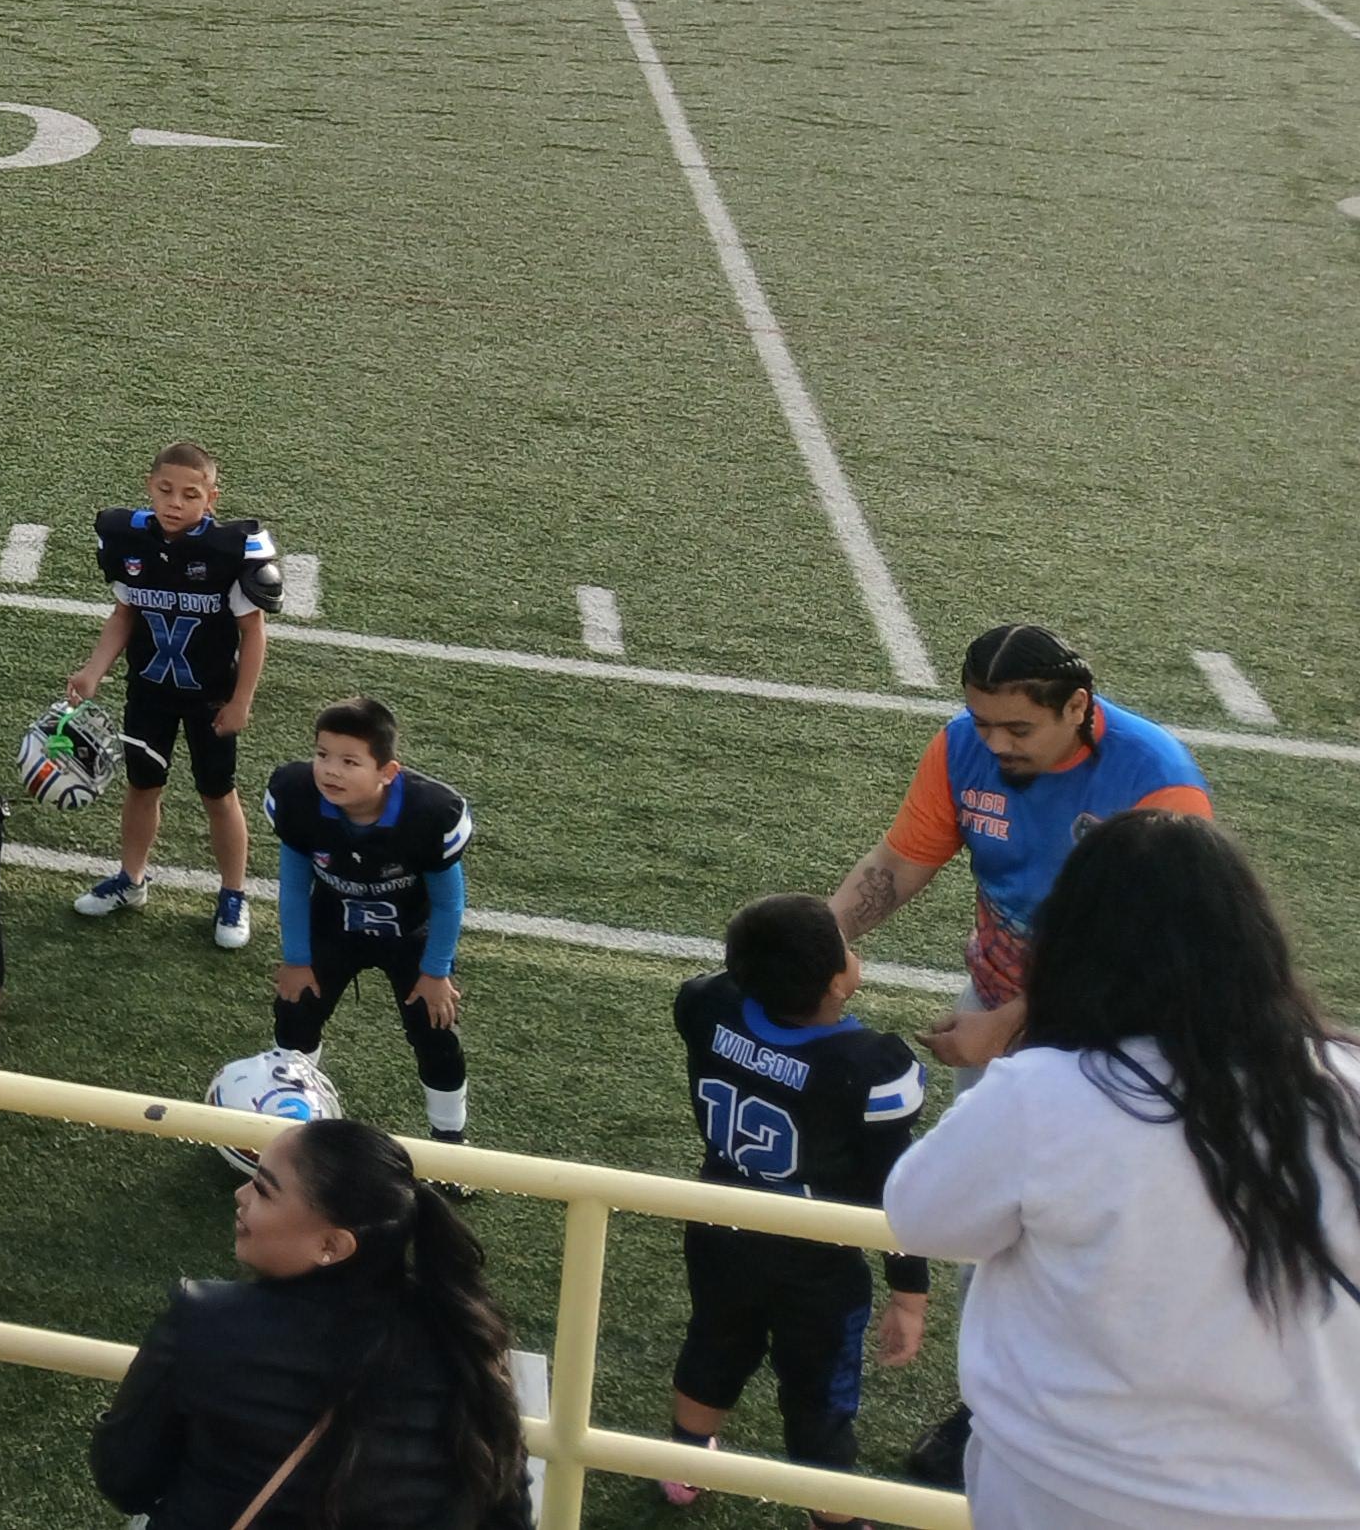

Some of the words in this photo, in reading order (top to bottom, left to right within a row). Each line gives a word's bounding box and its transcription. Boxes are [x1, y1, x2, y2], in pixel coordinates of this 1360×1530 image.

[139, 610, 202, 690] X
[712, 1023, 811, 1091] WILSON
[698, 1078, 804, 1187] 12
